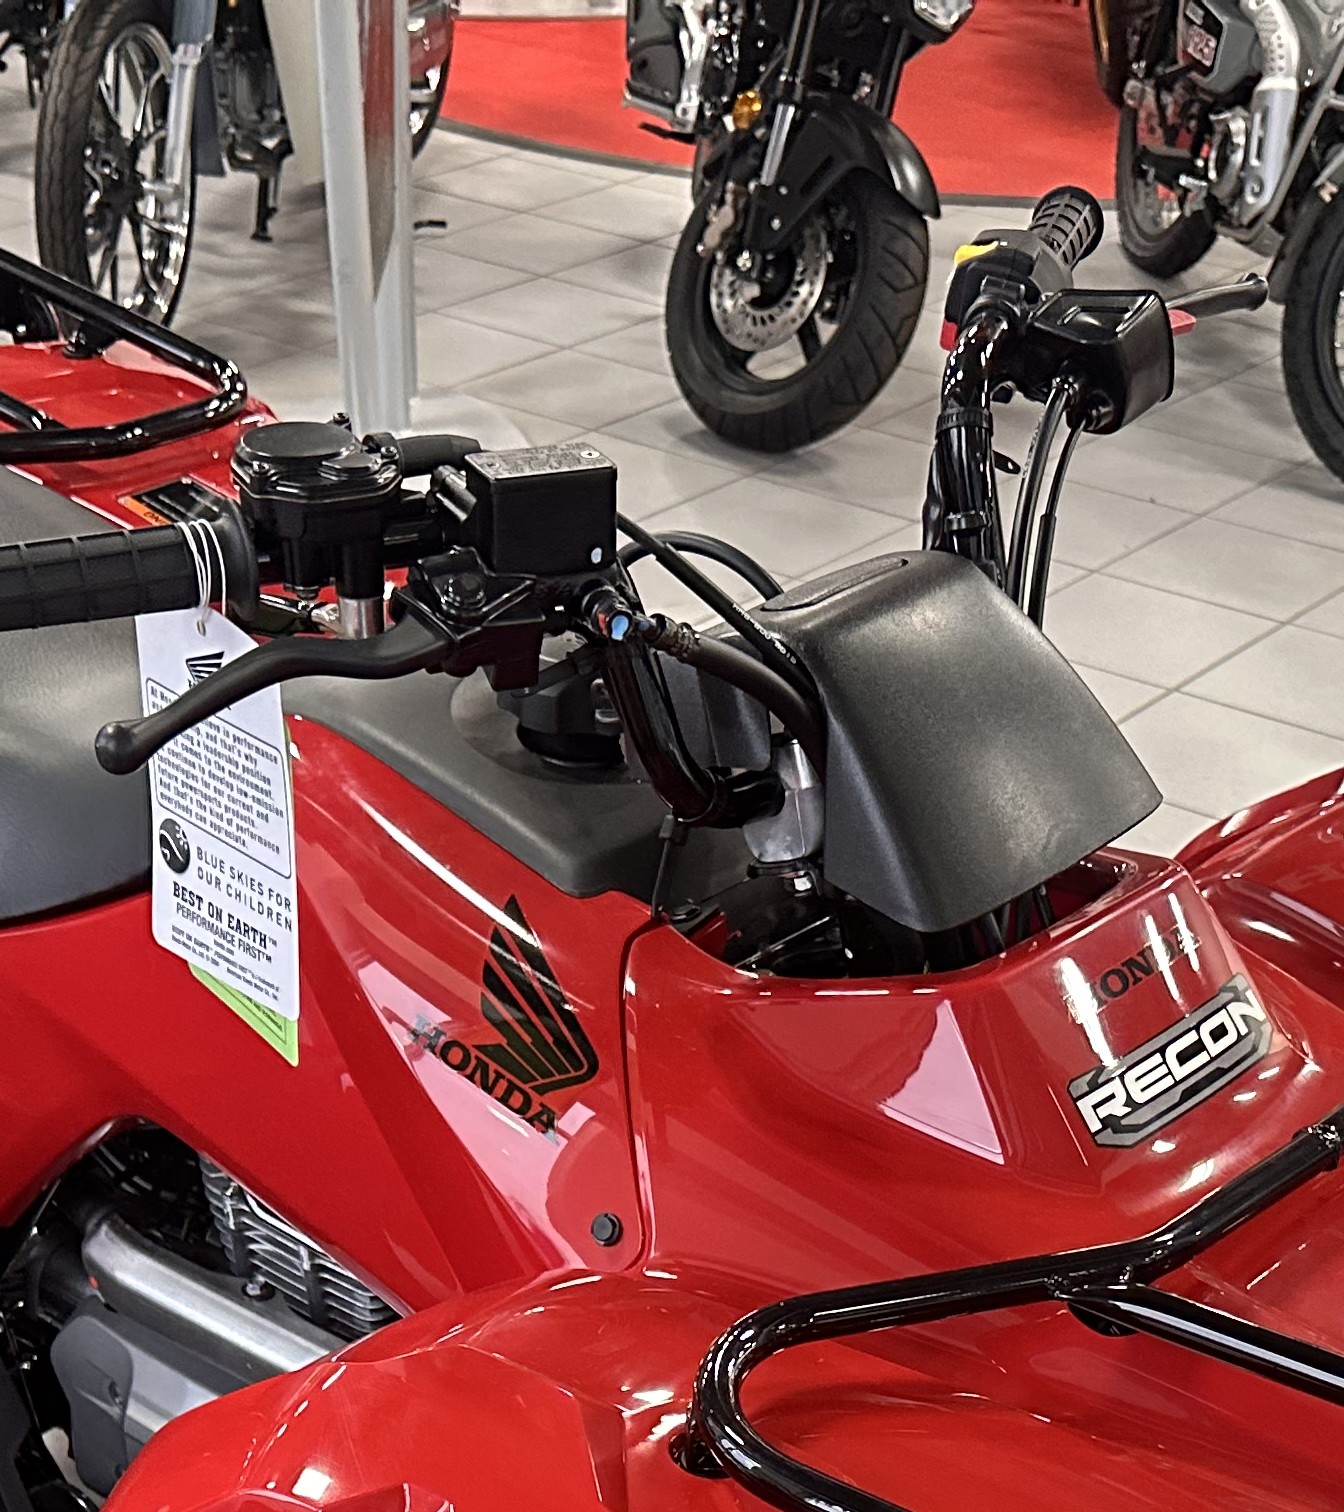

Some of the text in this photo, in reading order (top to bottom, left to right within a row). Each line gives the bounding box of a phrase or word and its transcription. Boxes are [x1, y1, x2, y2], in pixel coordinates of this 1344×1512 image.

[172, 880, 203, 912] BEST
[208, 901, 223, 924] ON
[196, 846, 292, 912] BLUE SKIES FOR
[197, 866, 293, 933] OUR CHILDREN
[176, 902, 236, 948] PERFORMANCE
[408, 1014, 561, 1146] HONDA
[1076, 989, 1267, 1134] RECON
